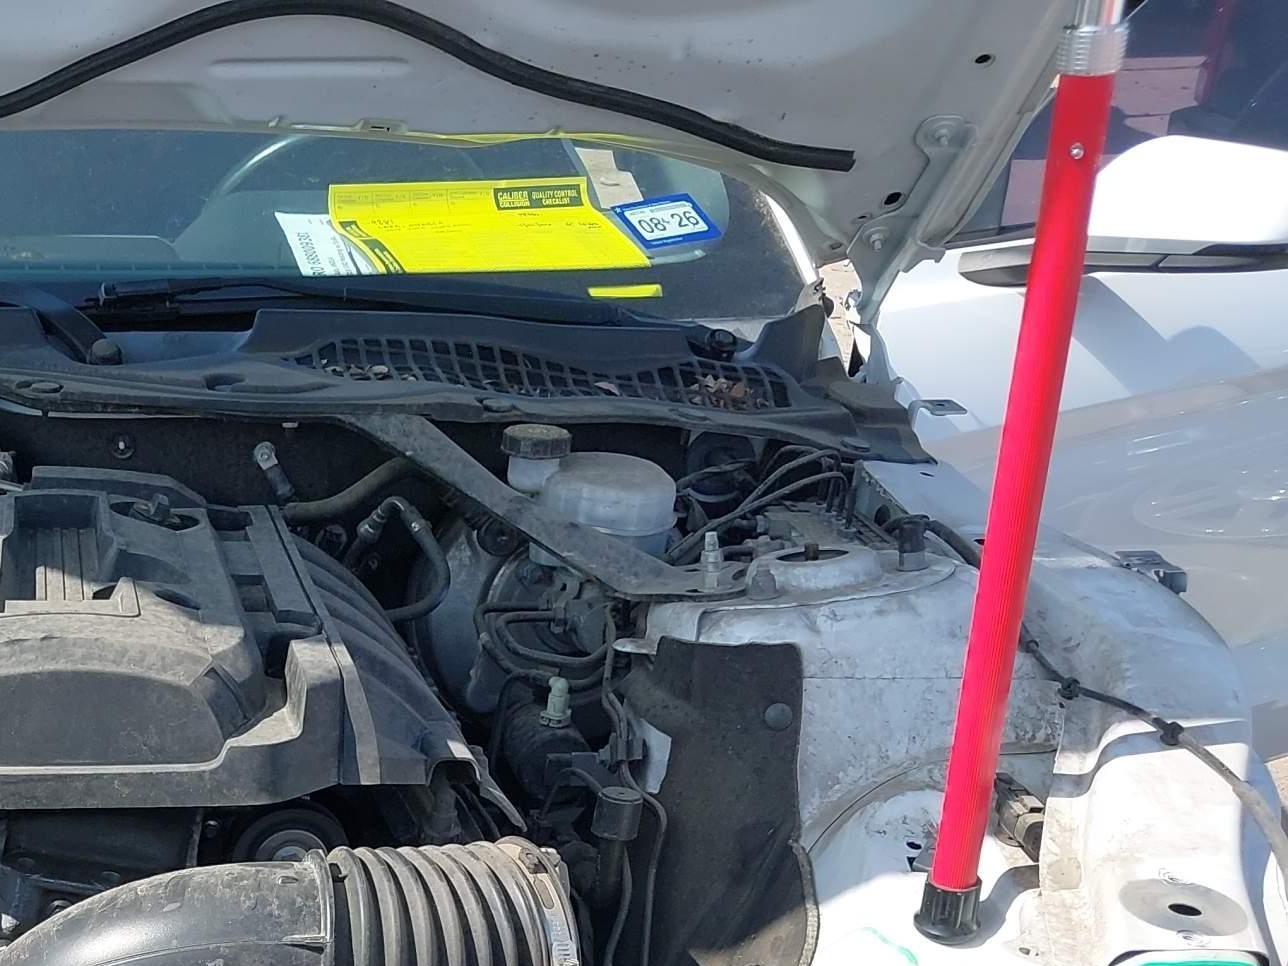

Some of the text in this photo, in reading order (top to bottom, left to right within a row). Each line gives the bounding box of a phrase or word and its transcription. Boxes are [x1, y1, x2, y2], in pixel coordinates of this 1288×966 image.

[497, 191, 528, 200] CALIBER
[531, 189, 578, 200] QUALITY CONTROL
[499, 200, 530, 208] COLLISION
[541, 197, 571, 206] CHECKLIST
[638, 210, 699, 234] 08 26
